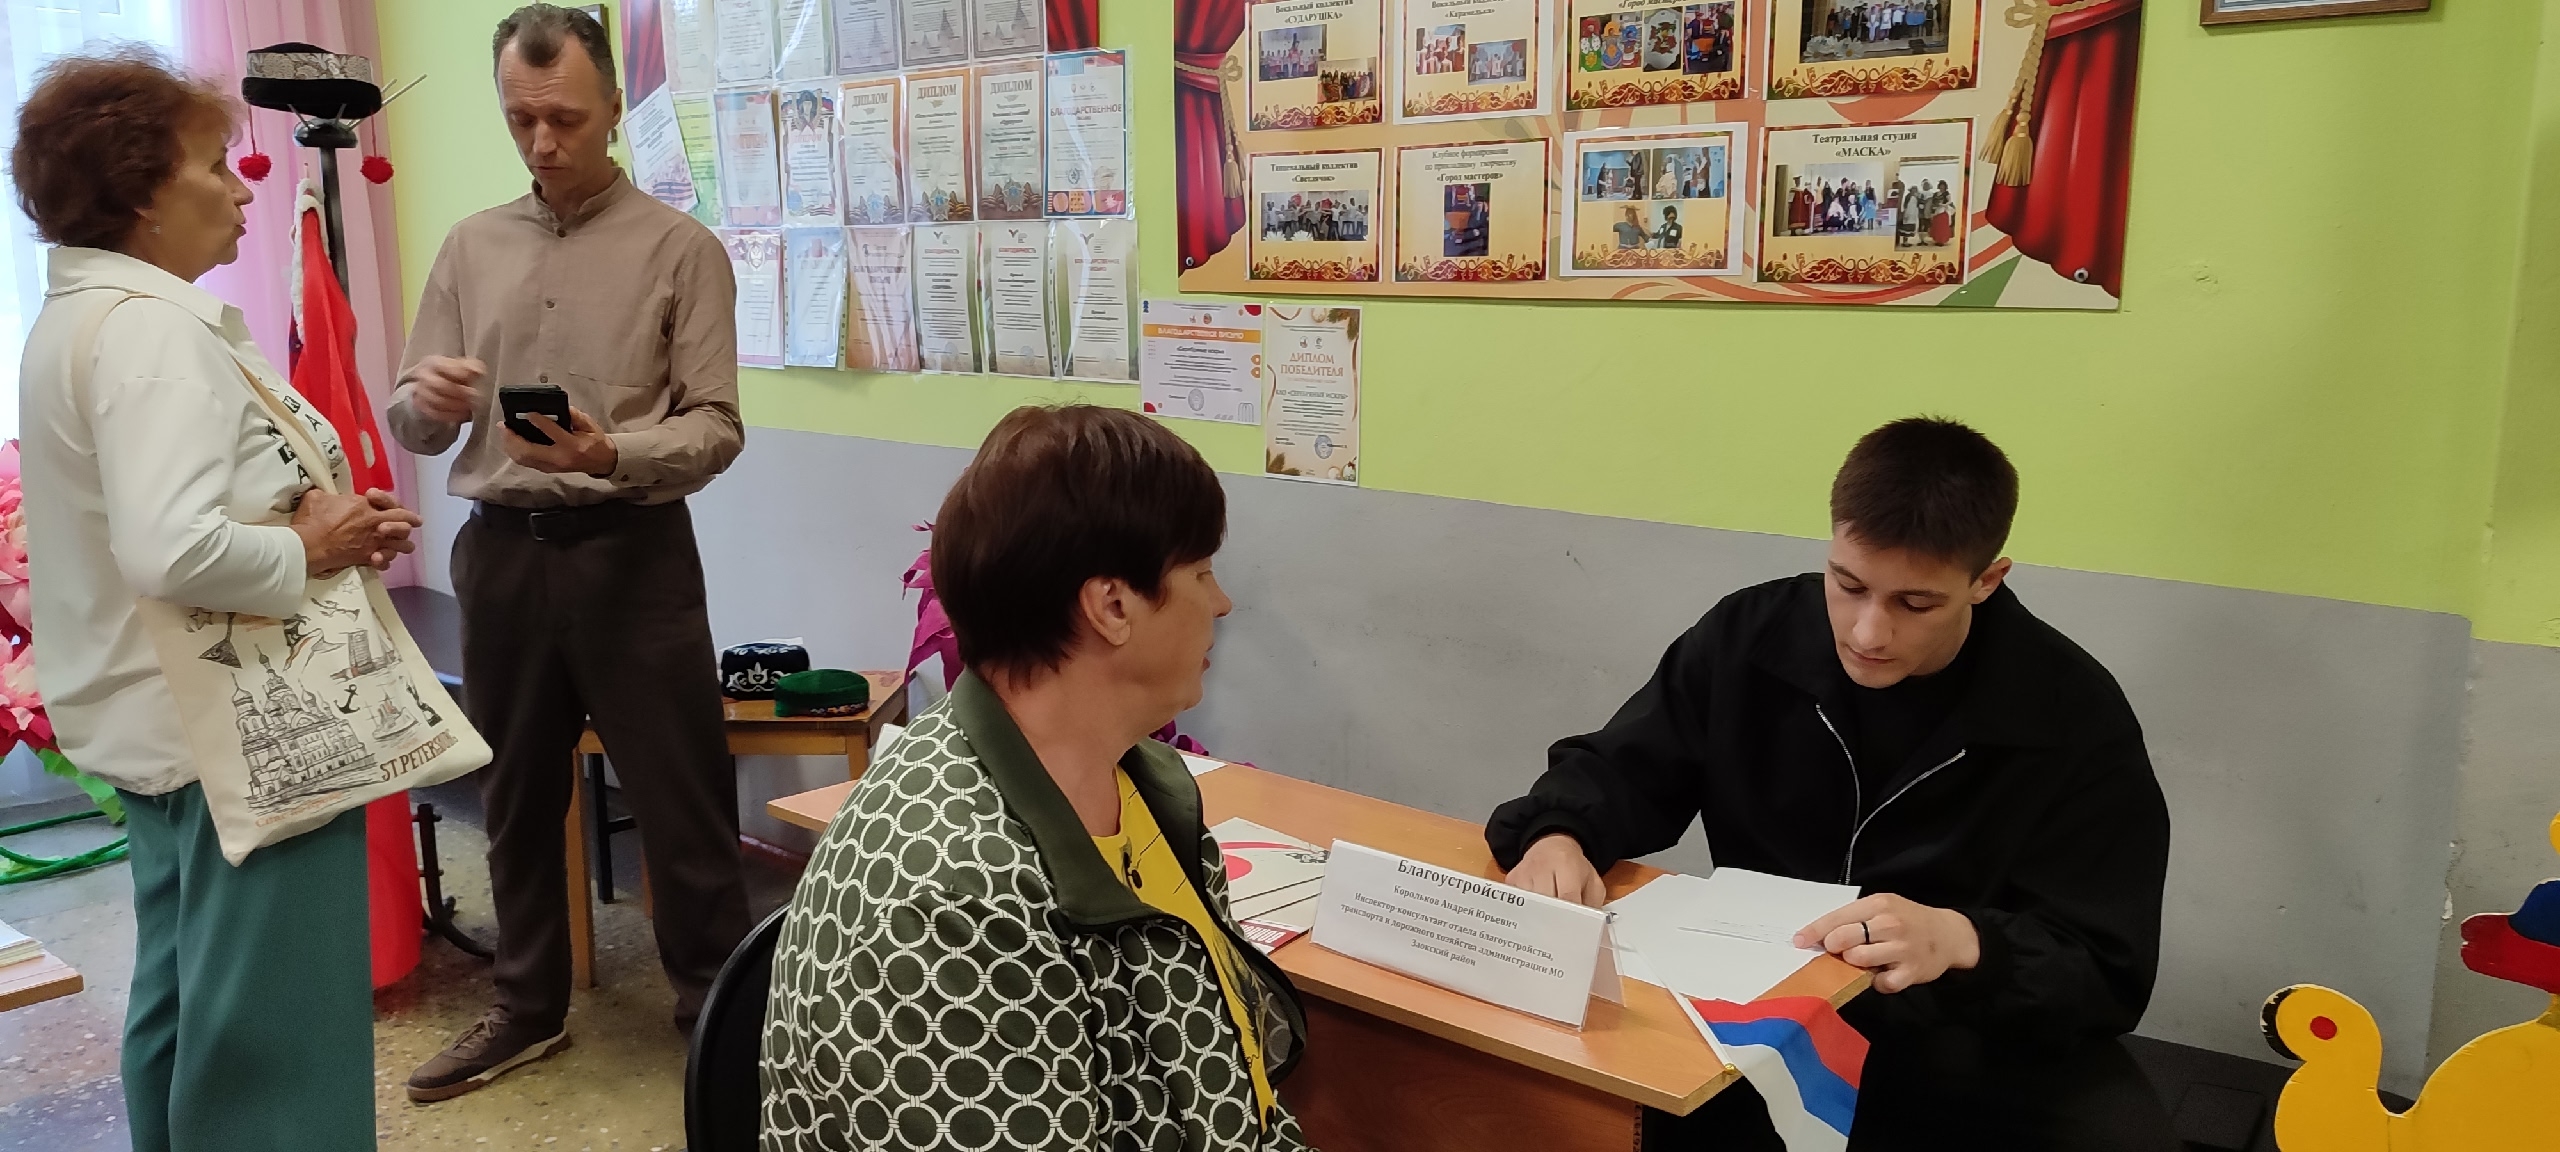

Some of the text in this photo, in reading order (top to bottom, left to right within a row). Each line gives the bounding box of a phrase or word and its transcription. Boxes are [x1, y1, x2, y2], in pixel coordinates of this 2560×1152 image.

[917, 83, 957, 100] ДИПЛОМ
[989, 78, 1033, 95] ДИПЛОМ
[851, 92, 889, 108] ДИПЛОМ
[1811, 131, 1918, 145] Театральная студия
[1835, 146, 1892, 158] «МАСКА»
[1289, 352, 1335, 365] ДИПЛОМ
[1280, 363, 1344, 377] ПОБЕДИТЕЛЯ
[1397, 859, 1526, 907] Благоустройство
[1393, 885, 1518, 929] Корольков Андрей Юрьевич
[1340, 903, 1384, 922] транспорта
[1390, 919, 1435, 939] дорожного
[1435, 932, 1477, 952] хозяйства
[1477, 946, 1548, 974] администрации
[1548, 966, 1565, 979] МО
[1448, 922, 1477, 937] отдела
[1479, 930, 1554, 961] благоустройства,
[1450, 952, 1477, 967] район
